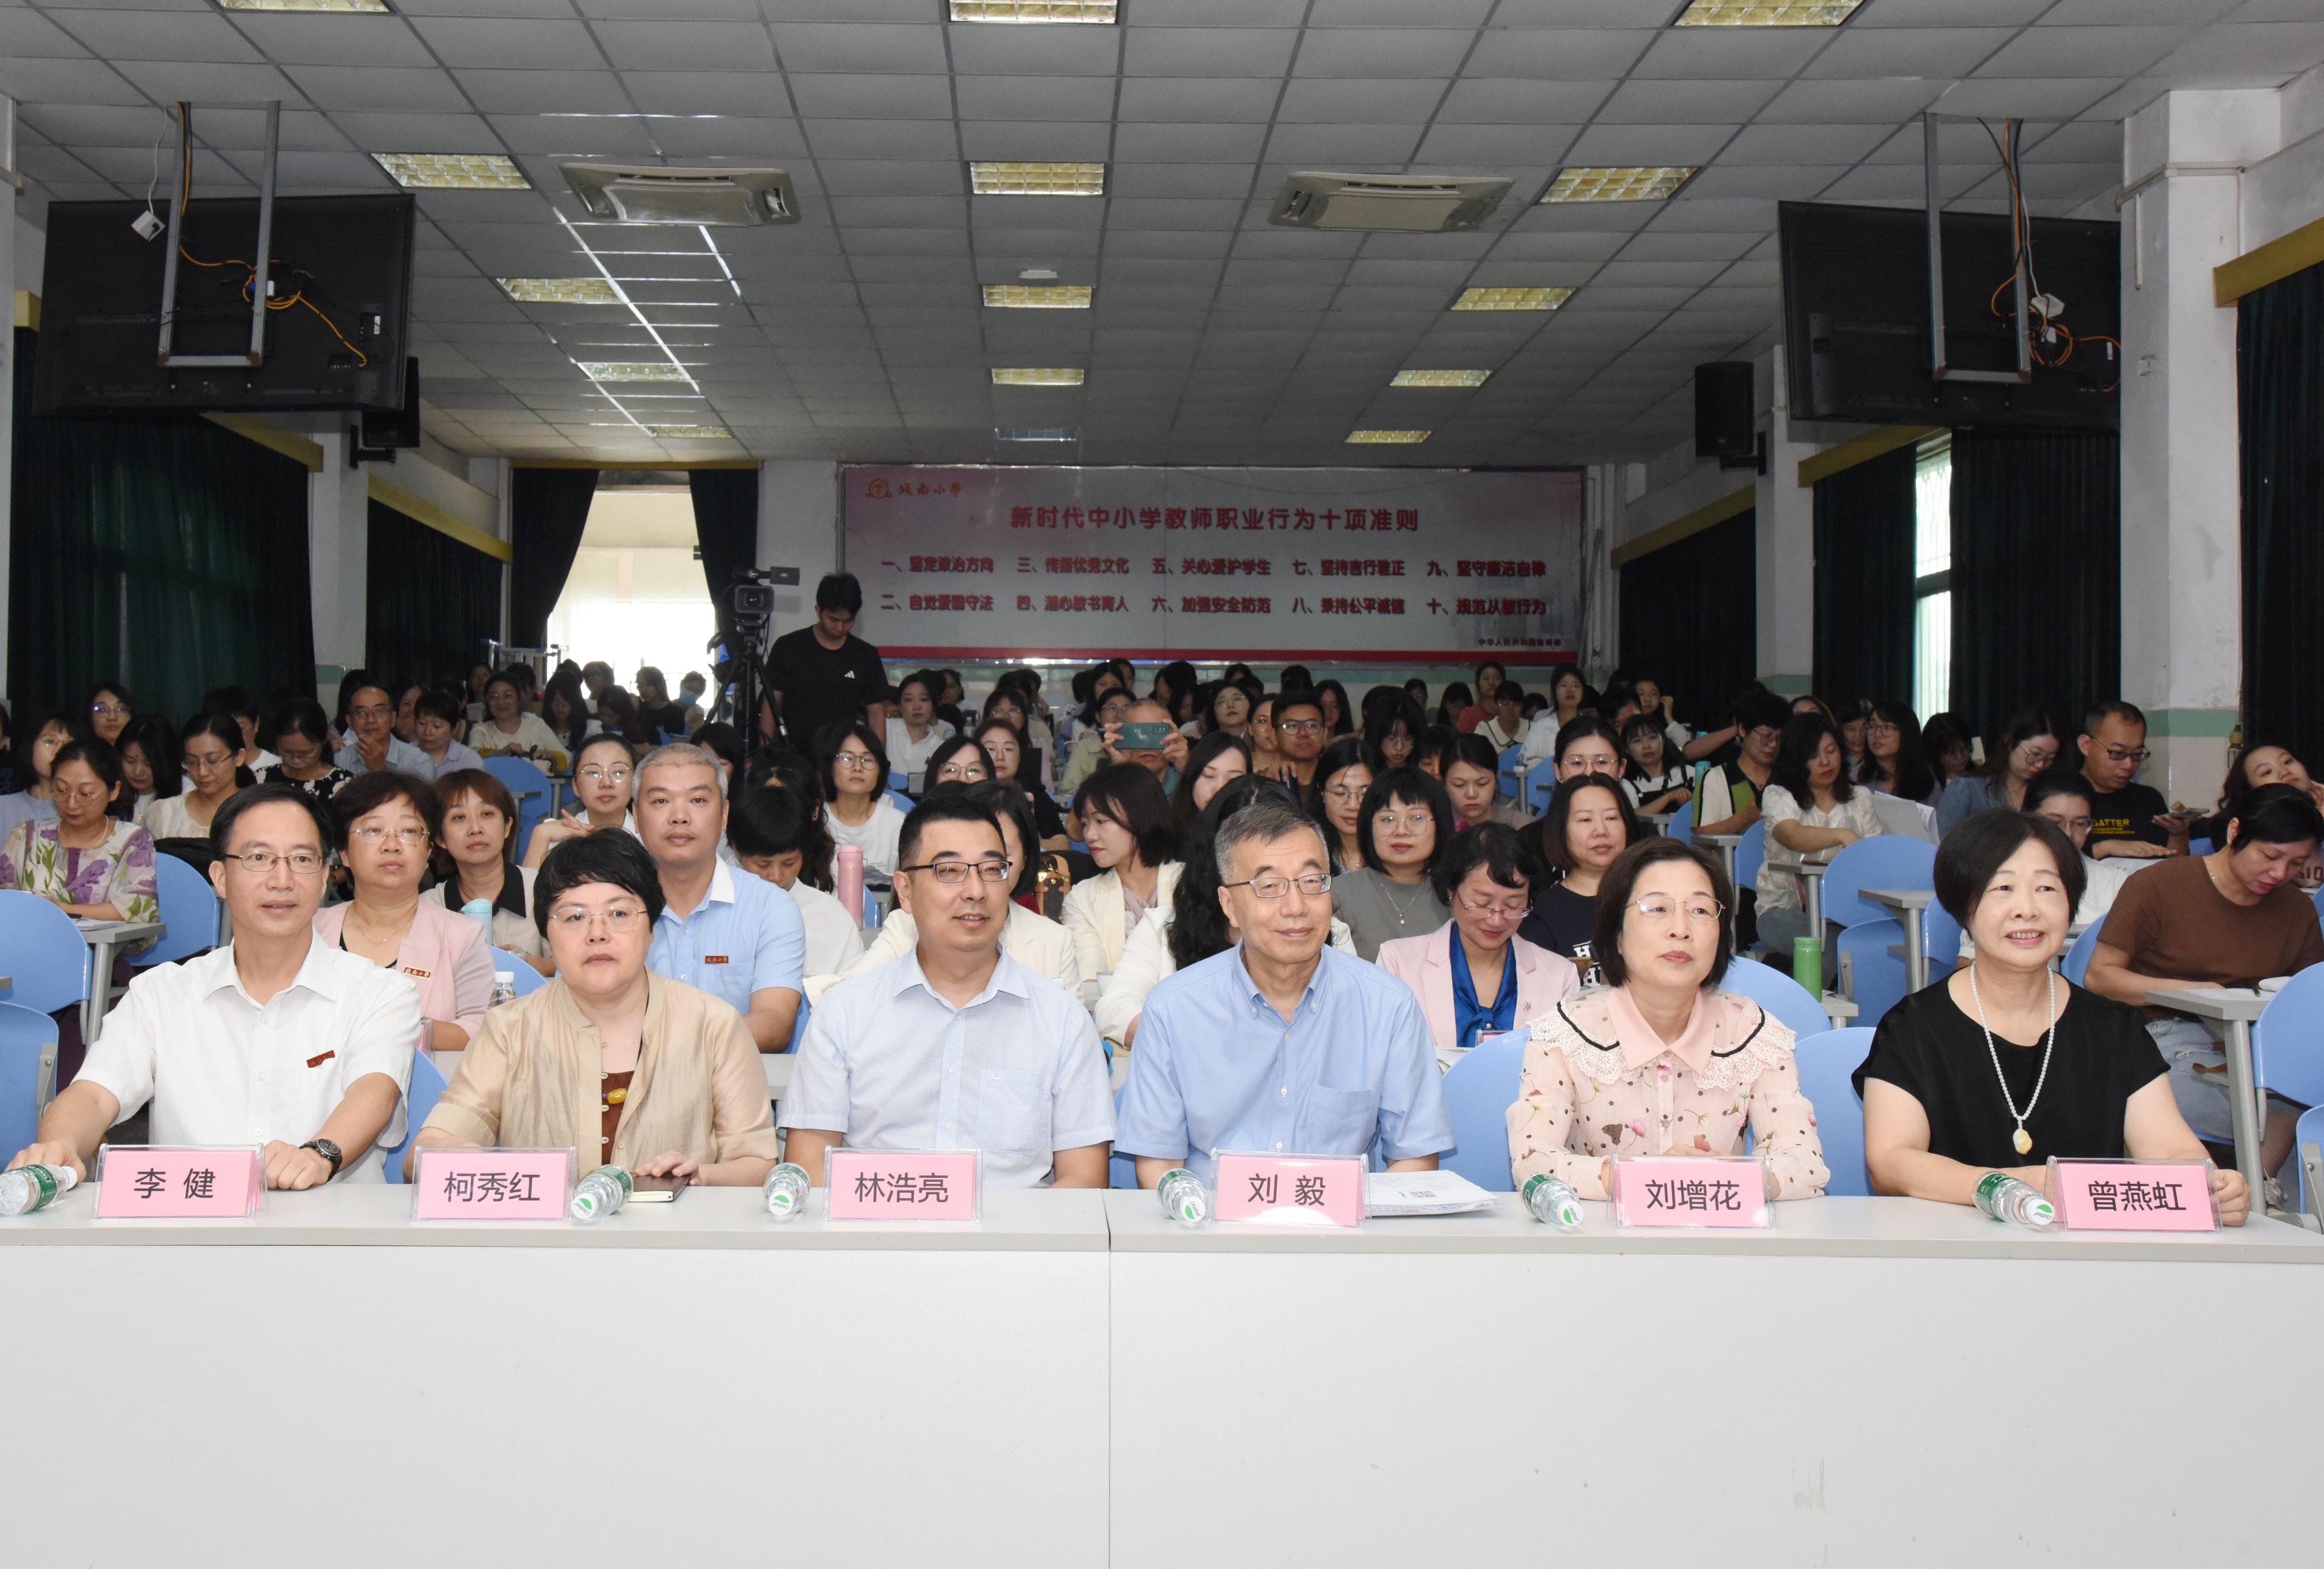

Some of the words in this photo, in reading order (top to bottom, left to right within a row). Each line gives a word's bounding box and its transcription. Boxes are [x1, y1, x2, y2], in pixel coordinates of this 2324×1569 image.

[1011, 506, 1418, 531] 新时代中小学教师职业行为十项准则
[444, 1171, 540, 1202] 柯秀红
[855, 1172, 948, 1203] 林浩亮
[1645, 1179, 1741, 1211] 刘增花
[2088, 1180, 2186, 1211] 曾燕虹
